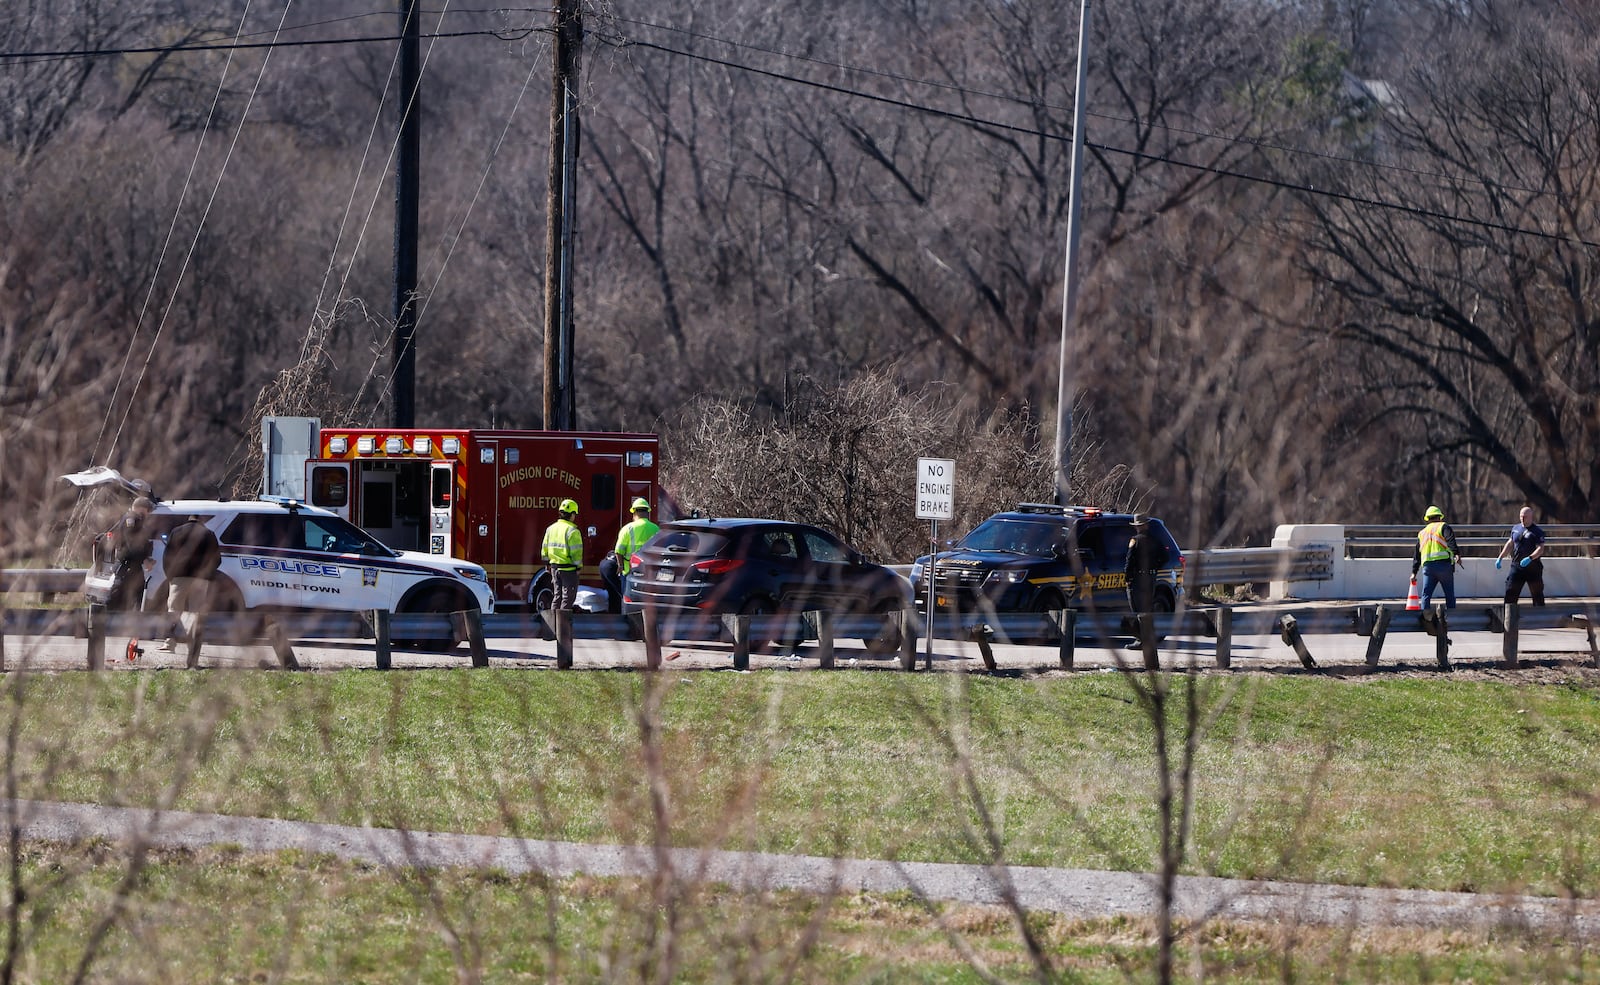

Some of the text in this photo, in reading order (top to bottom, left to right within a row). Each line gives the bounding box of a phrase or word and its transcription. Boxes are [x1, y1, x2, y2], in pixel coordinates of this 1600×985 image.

[500, 466, 581, 490] DIVISION OF FIRE
[928, 465, 944, 477] NO
[920, 482, 951, 496] ENGINE
[509, 496, 573, 509] MIDDLETO
[920, 500, 949, 513] BRAKE
[240, 556, 341, 578] POLICE
[250, 579, 341, 594] MIDDLETOWN
[1097, 573, 1127, 590] SHER
